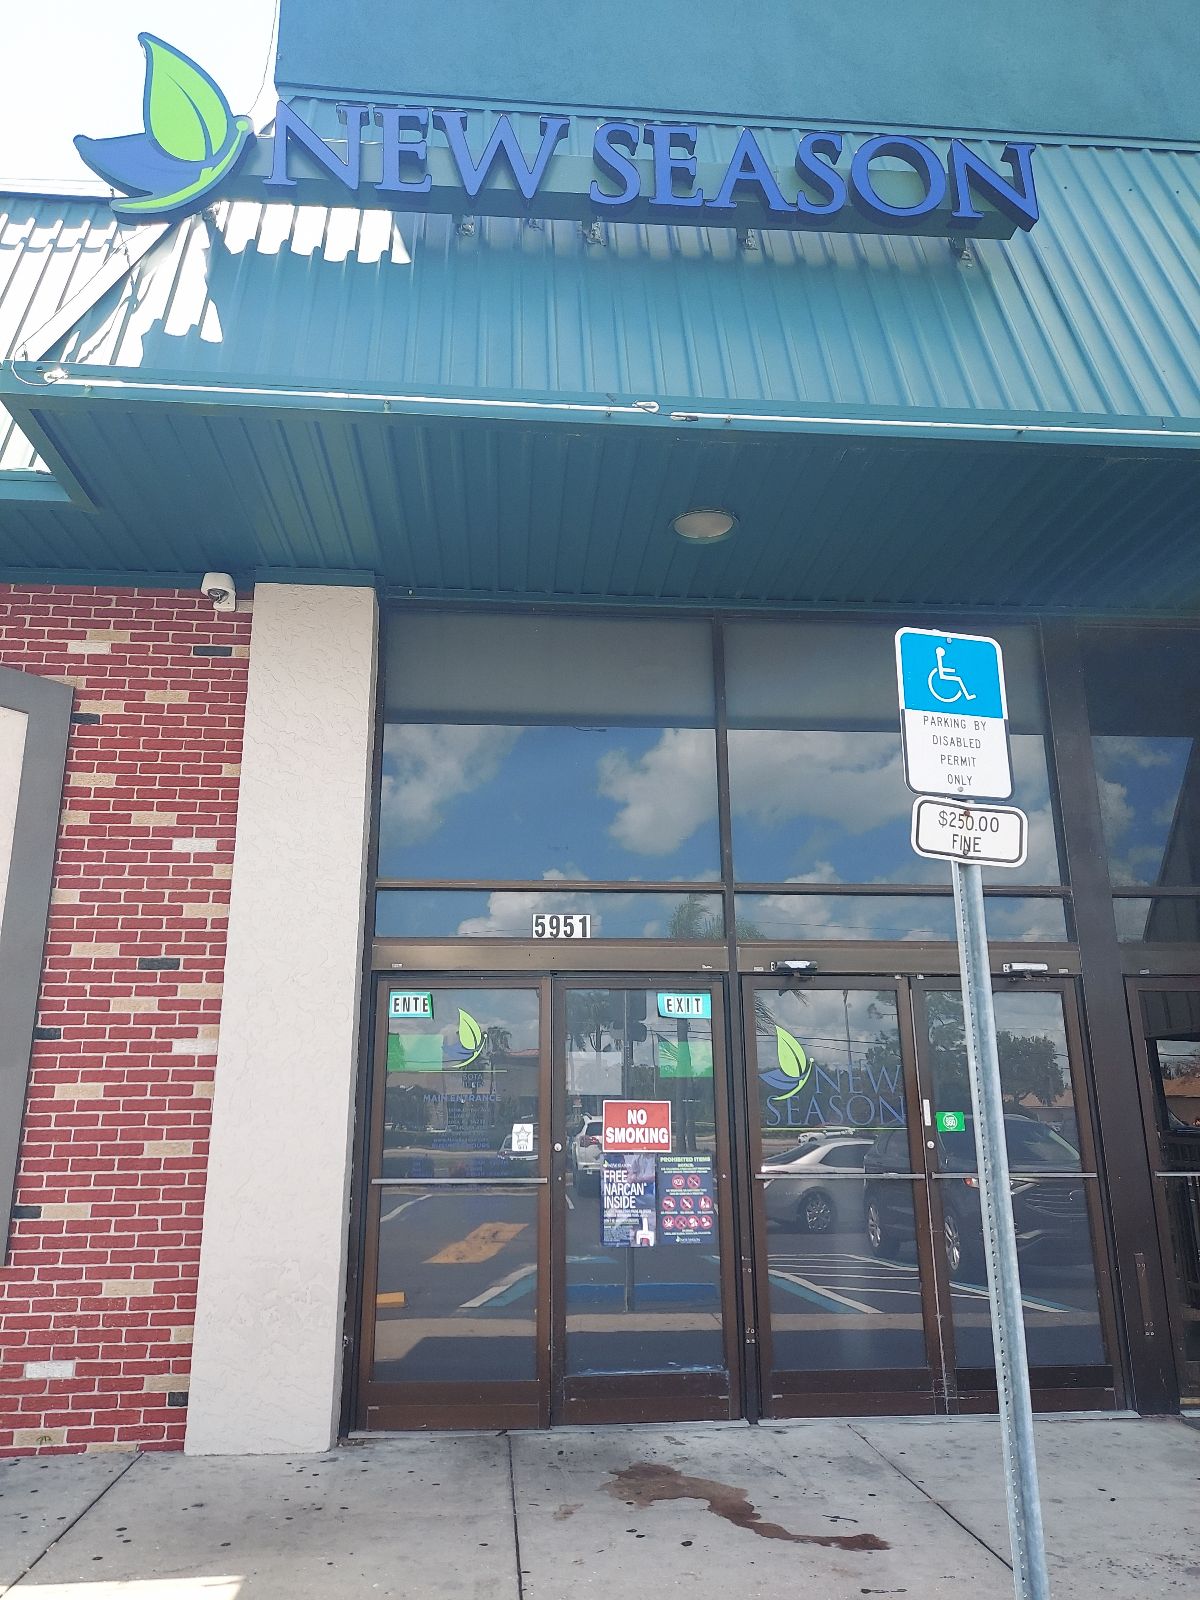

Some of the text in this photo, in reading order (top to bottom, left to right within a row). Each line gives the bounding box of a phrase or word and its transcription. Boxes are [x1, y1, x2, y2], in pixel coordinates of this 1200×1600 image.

[263, 100, 1040, 222] NEW SEASON
[923, 715, 987, 732] PARKING BY
[932, 734, 982, 749] DISABLED
[940, 754, 977, 768] PERMIT
[947, 773, 973, 786] ONLY
[938, 809, 1000, 833] $250.00
[952, 833, 982, 853] FINE
[534, 914, 588, 939] 5951
[666, 998, 701, 1013] EXIT
[813, 1063, 905, 1095] NEW
[627, 1109, 648, 1125] NO
[766, 1095, 907, 1127] SEASON
[605, 1127, 669, 1144] SMOKING
[603, 1170, 628, 1183] FREE
[603, 1196, 636, 1209] INSIDE
